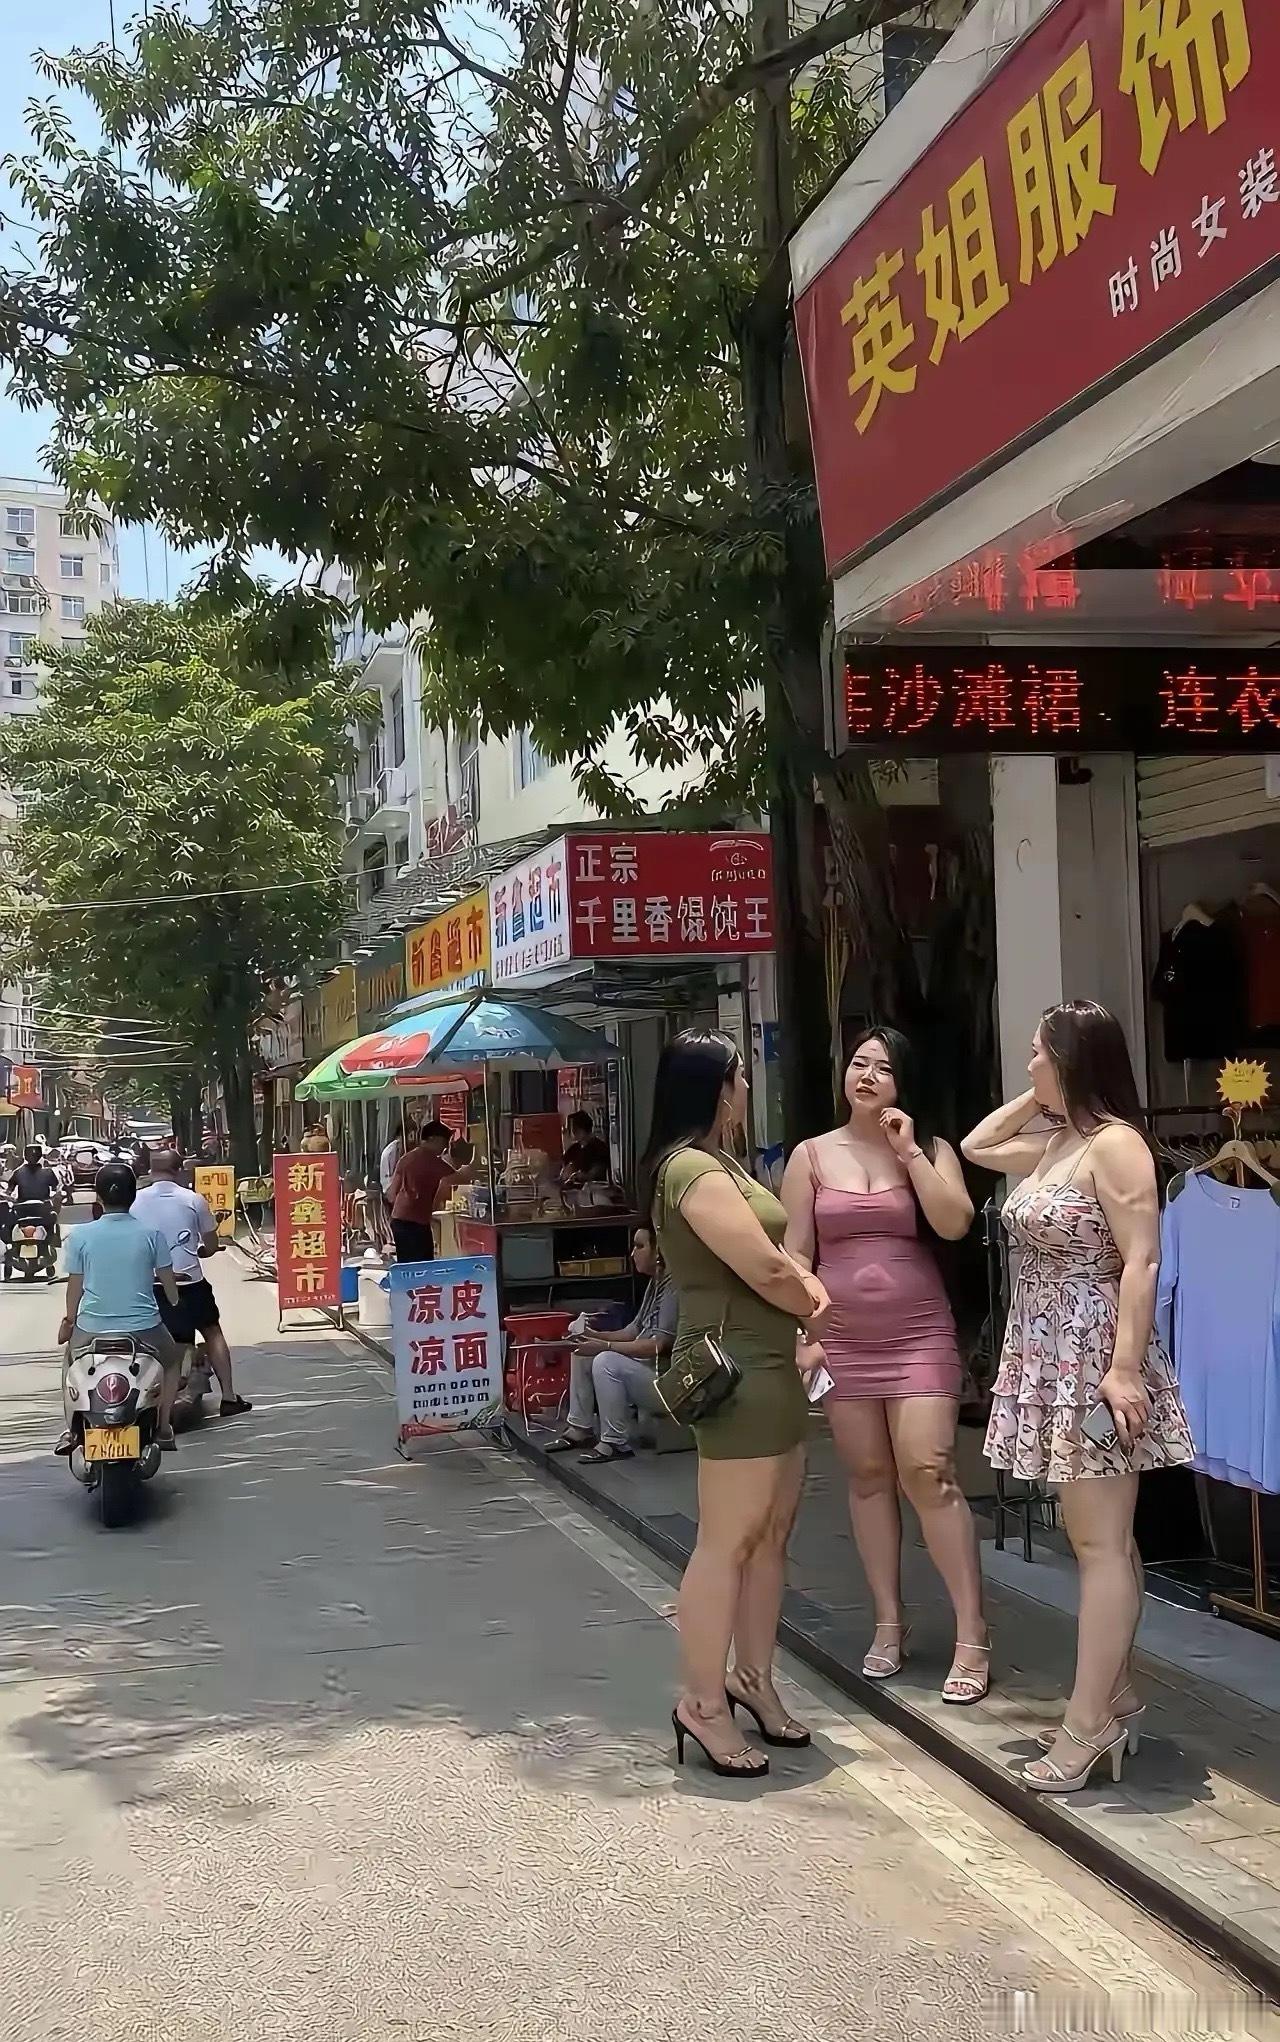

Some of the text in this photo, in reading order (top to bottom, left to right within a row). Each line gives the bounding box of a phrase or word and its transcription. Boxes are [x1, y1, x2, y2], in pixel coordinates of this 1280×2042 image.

[840, 0, 1251, 435] 英姐服饰
[1108, 147, 1280, 318] 时尚女装
[576, 841, 639, 885] 正宗
[575, 893, 773, 945] 千里香馄饨王
[405, 1279, 487, 1324] 凉皮
[408, 1331, 488, 1376] 凉面
